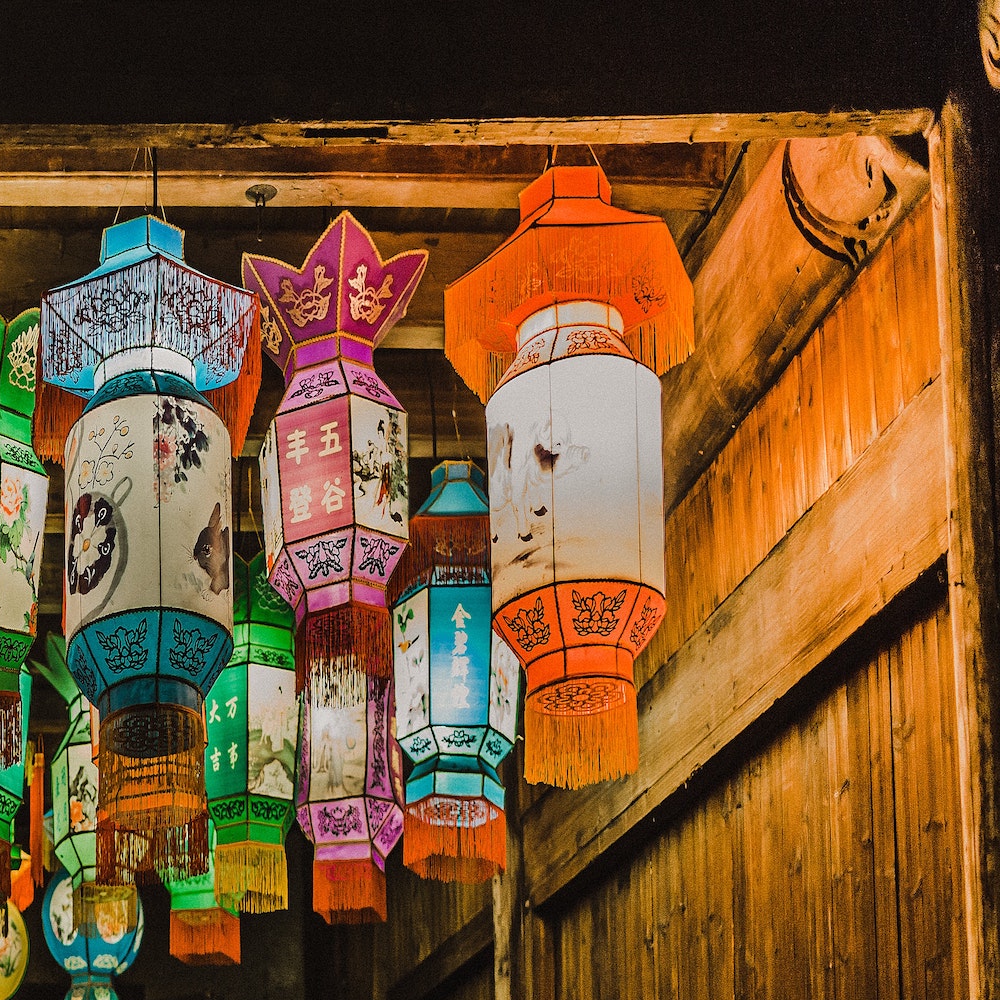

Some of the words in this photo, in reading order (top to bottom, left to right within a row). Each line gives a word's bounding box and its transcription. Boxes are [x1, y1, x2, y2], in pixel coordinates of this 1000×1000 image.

[318, 421, 345, 514] 五谷
[209, 699, 221, 772] 大吉
[225, 696, 238, 770] 万事
